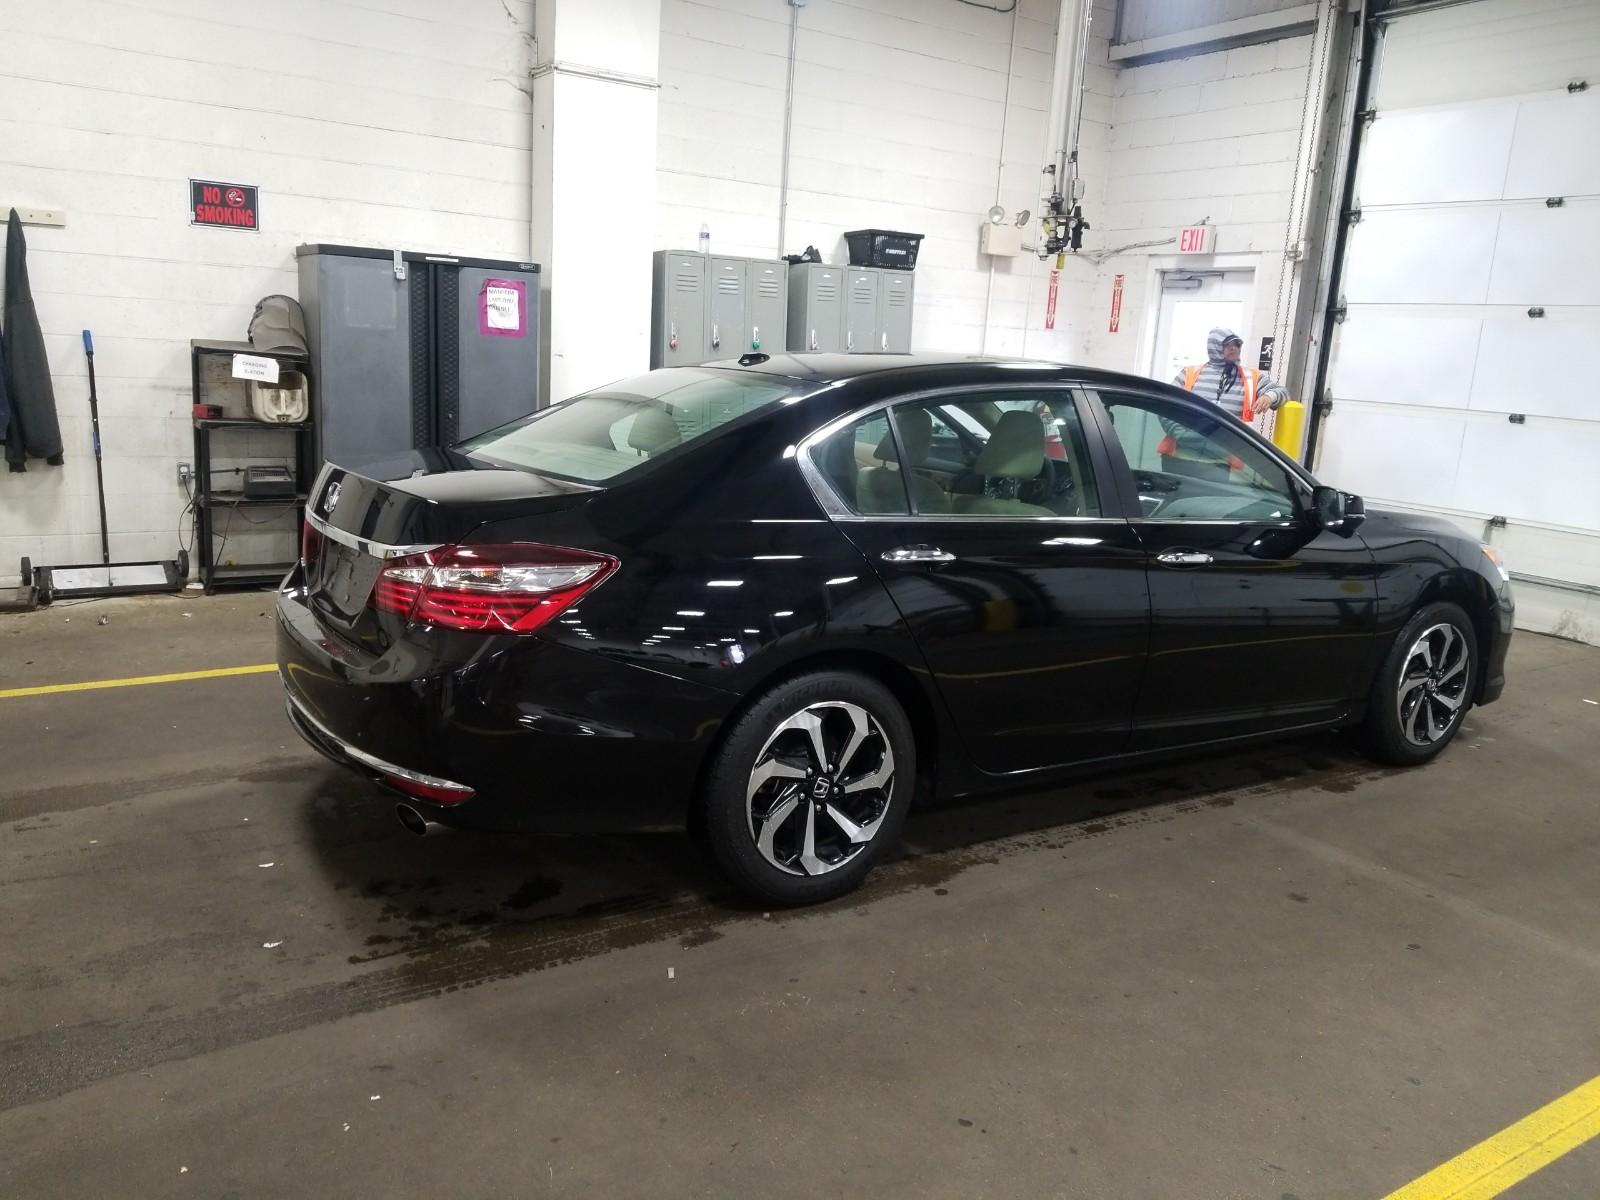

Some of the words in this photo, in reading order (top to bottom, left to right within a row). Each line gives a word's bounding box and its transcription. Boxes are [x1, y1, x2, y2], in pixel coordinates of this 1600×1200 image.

[203, 186, 221, 204] NO
[196, 204, 254, 226] SMOKING
[1180, 229, 1206, 252] EXIT
